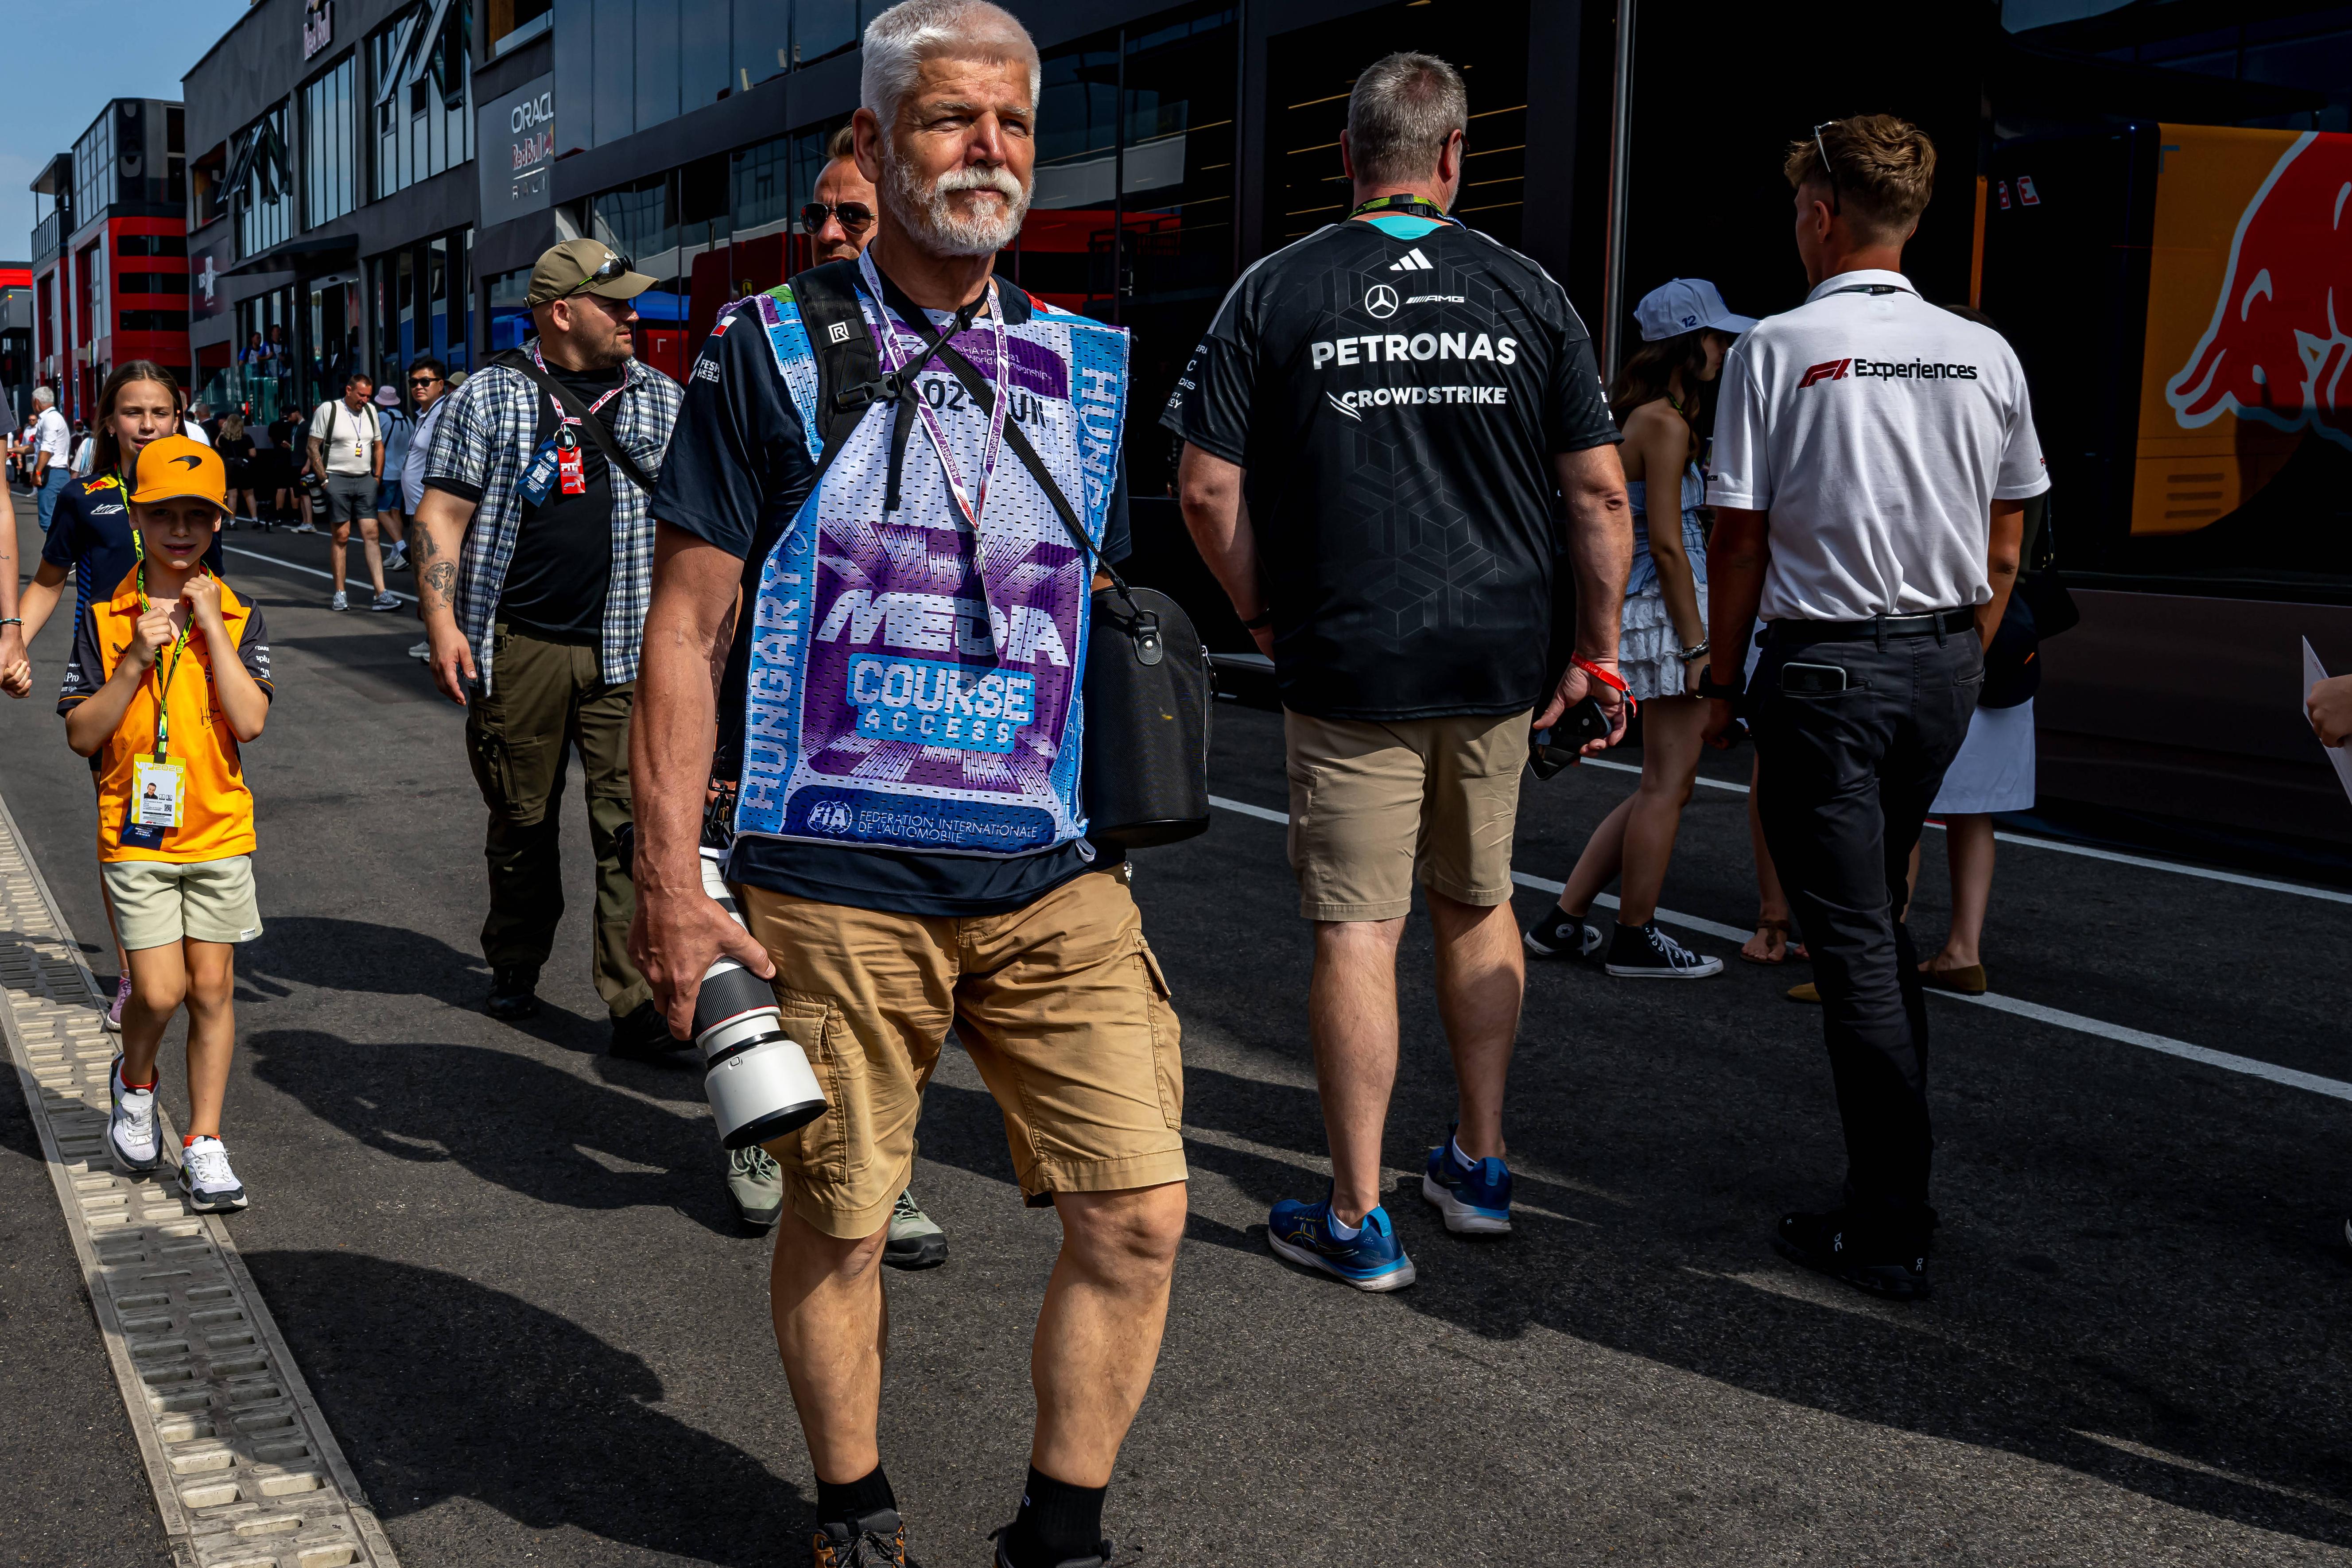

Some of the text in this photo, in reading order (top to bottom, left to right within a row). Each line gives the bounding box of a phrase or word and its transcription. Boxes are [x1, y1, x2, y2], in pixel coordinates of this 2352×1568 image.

[512, 91, 554, 133] ORACL
[1424, 295, 1465, 304] AMG
[1681, 315, 1697, 328] 12
[1311, 332, 1518, 370] PETRONAS
[700, 359, 720, 373] FESH
[1854, 357, 1978, 381] Experiences
[1342, 386, 1507, 408] CROWDSTRIKE
[987, 430, 999, 465] HUNGARY
[560, 463, 578, 472] PIT
[939, 443, 959, 479] HUNGARY
[815, 589, 1070, 667] MEDIA
[256, 655, 270, 664] splu
[1585, 664, 1599, 673] CLUB
[64, 672, 79, 682] Pro
[745, 558, 801, 811] HUNGARY
[853, 660, 1032, 722] COURSE
[864, 709, 1009, 743] ACCESS
[135, 761, 153, 771] VIP
[858, 821, 962, 843] DE L'AUTOMOBILE
[860, 810, 935, 828] FEDERATION
[939, 819, 1038, 838] INTERNATIONALE
